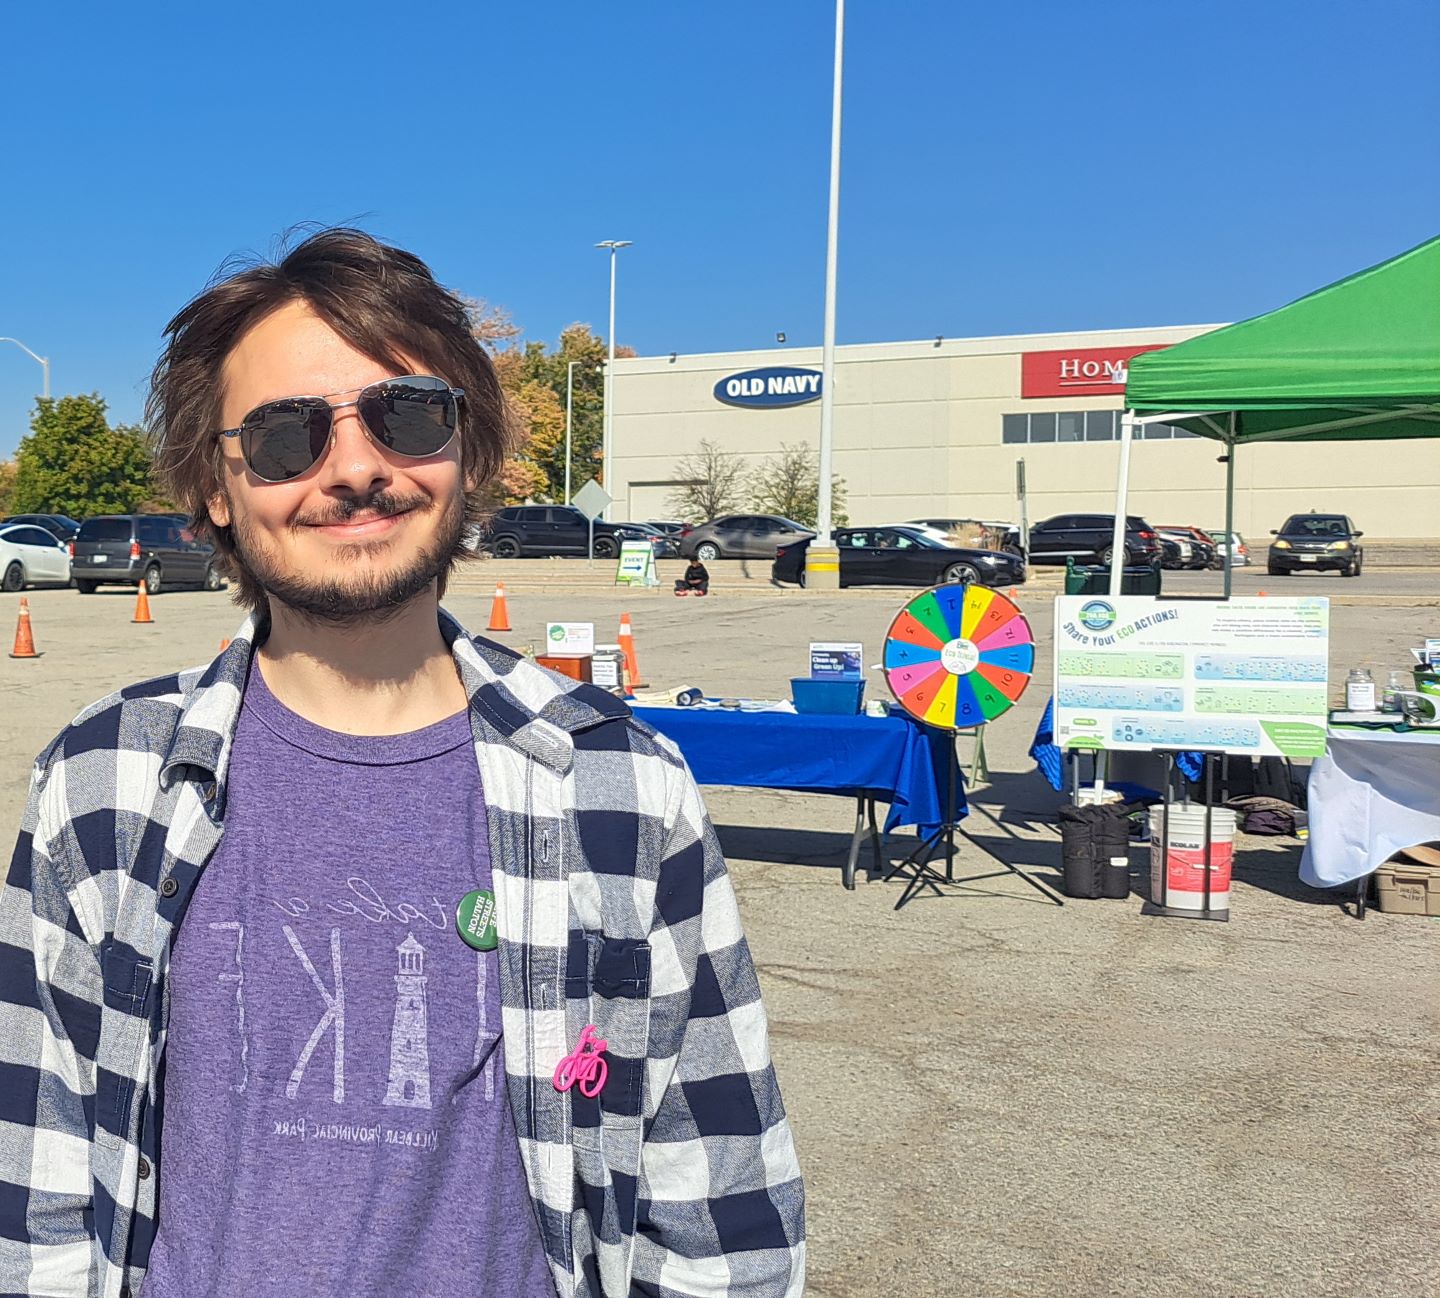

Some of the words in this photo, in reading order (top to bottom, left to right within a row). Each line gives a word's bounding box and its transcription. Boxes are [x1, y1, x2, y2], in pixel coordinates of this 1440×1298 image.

[726, 378, 764, 397] OLD
[767, 374, 821, 395] NAVY
[946, 598, 956, 610] 1
[971, 600, 983, 610] 14
[923, 607, 932, 616] 2
[990, 610, 1003, 622] 13
[1062, 621, 1090, 644] Share
[1092, 634, 1116, 647] Your
[1116, 624, 1136, 640] ECO
[1134, 608, 1179, 631] ACTIONS!
[1009, 653, 1019, 662] 11
[902, 673, 912, 682] 5
[1000, 673, 1013, 686] 10
[916, 692, 924, 702] 6
[984, 694, 996, 704] 9
[939, 702, 946, 713] 7
[961, 702, 972, 715] 8
[467, 895, 485, 934] HALTON
[476, 898, 494, 938] STREETS
